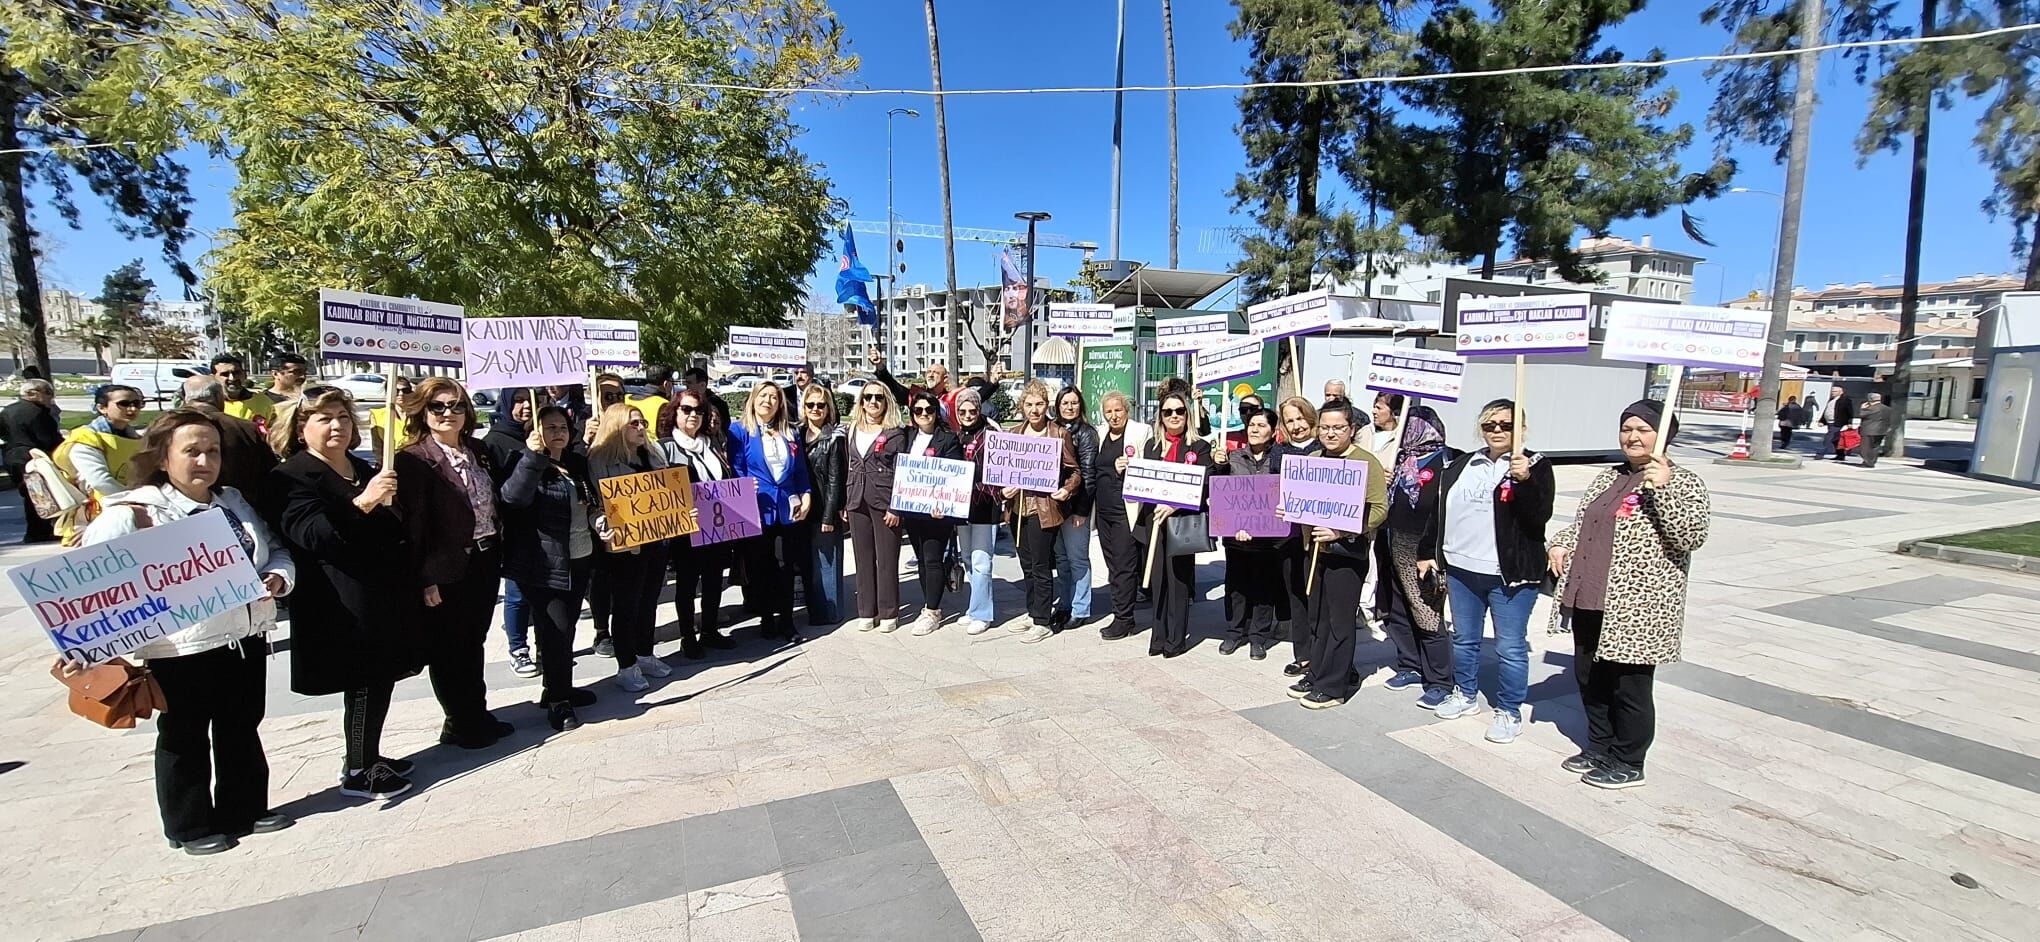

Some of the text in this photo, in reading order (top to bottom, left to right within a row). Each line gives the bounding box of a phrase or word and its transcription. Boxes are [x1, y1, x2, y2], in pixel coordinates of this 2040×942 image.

[326, 305, 363, 321] KADINLAR
[365, 309, 385, 323] BİREY
[386, 313, 405, 326] OLDU,
[436, 317, 460, 332] SAYILDI
[465, 318, 585, 341] KADIN VARSA
[472, 345, 588, 379] YAŞAM VAR
[602, 471, 667, 499] YAŞASIN
[1212, 476, 1256, 493] KADIN
[1283, 458, 1362, 487] Haklarımızdan
[630, 487, 686, 516] KADIN
[712, 501, 725, 528] 8
[1223, 492, 1272, 512] YAŞAM
[1282, 491, 1360, 520] Vazgeçmiyoruz
[701, 521, 747, 545] MART
[19, 544, 139, 599] Kırlarda
[35, 580, 139, 628] Direnen
[50, 594, 171, 650] Kentimde
[62, 618, 168, 665] Devrimci
